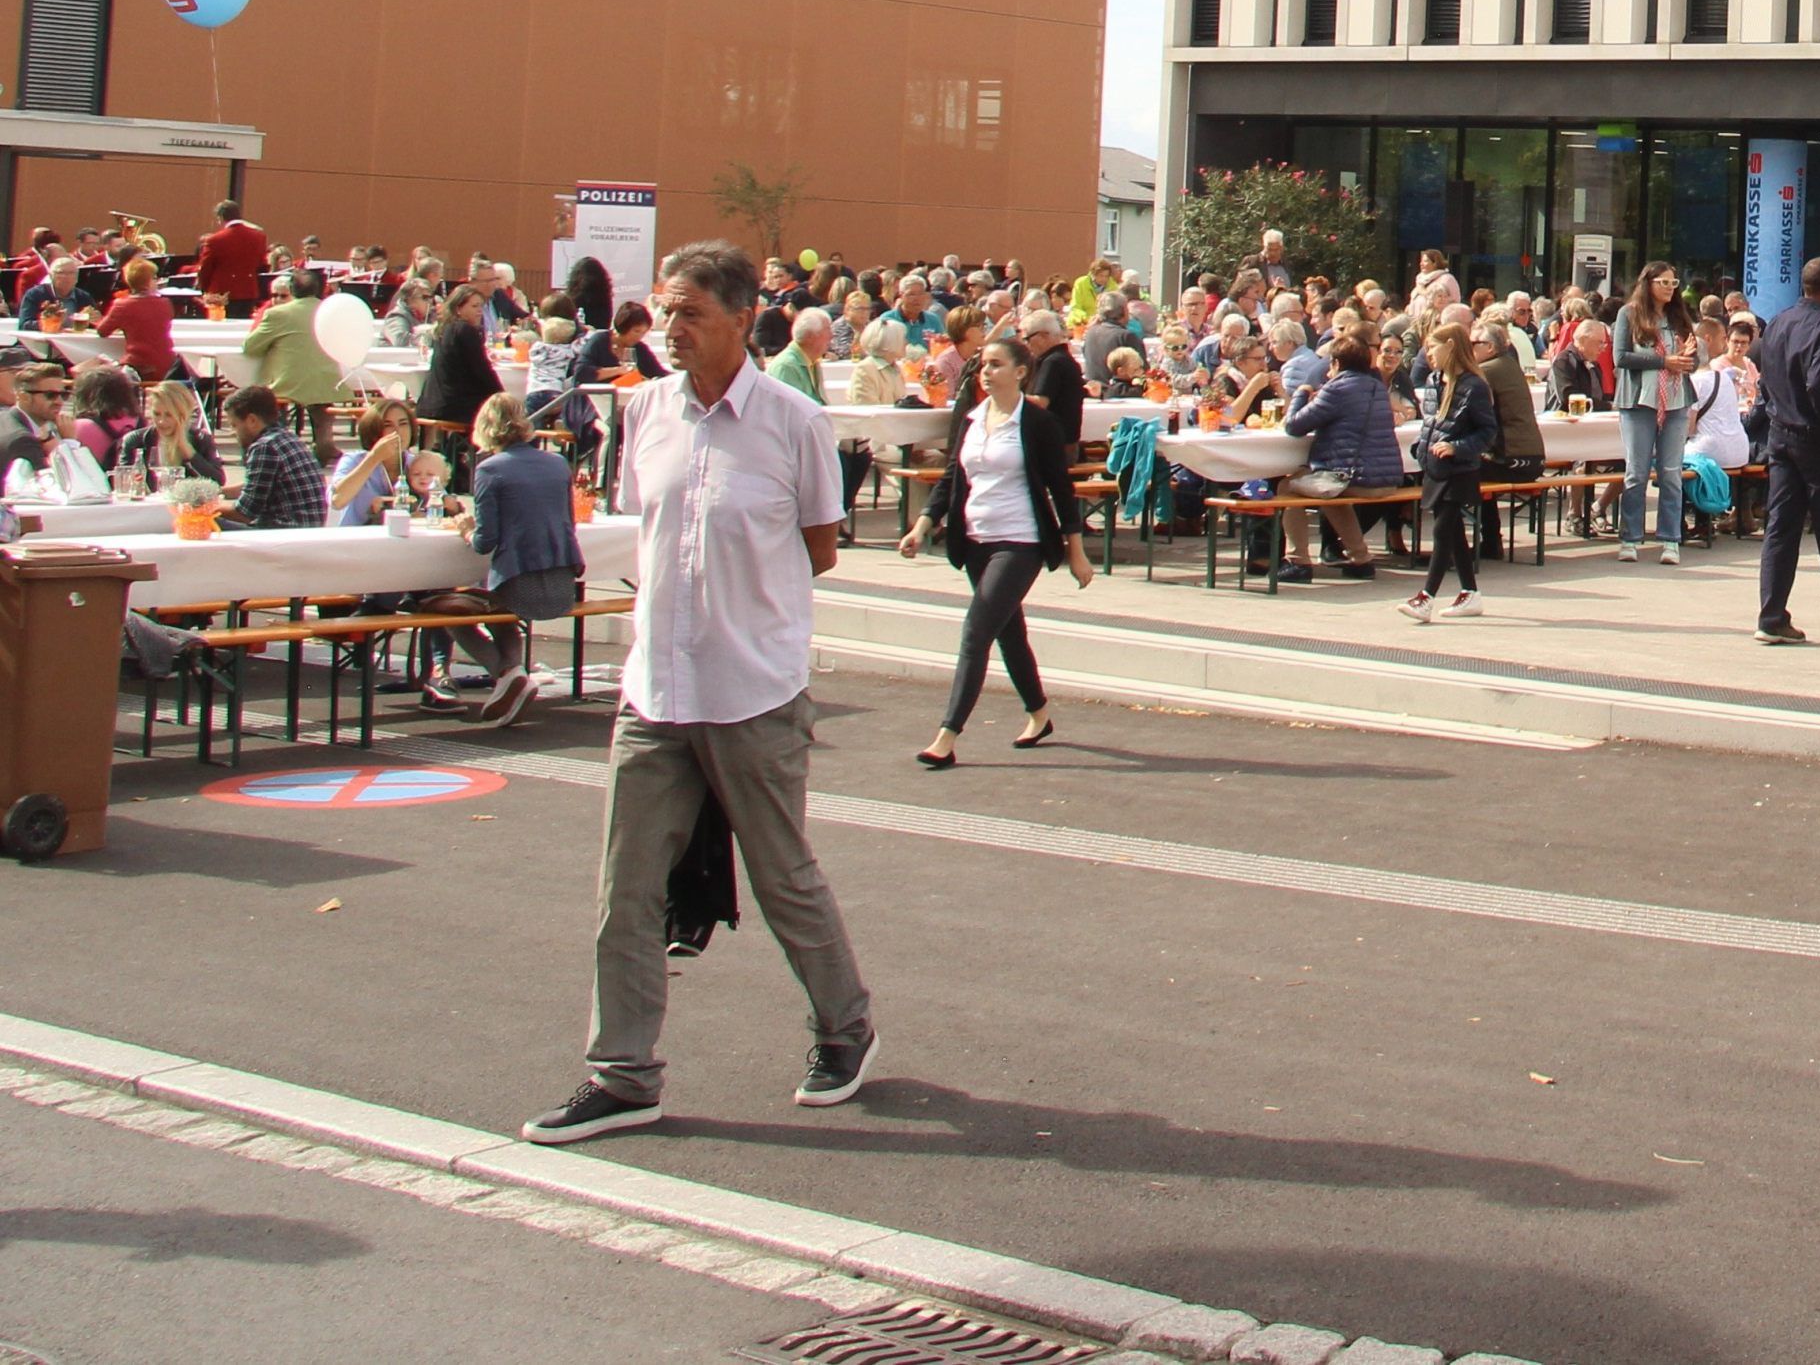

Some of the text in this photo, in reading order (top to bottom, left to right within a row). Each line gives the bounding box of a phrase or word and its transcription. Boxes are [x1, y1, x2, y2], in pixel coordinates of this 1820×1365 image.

[170, 137, 228, 148] TIEFGARAGE
[580, 190, 643, 203] POLIZEI
[1745, 177, 1761, 297] SPARKASSE
[1780, 202, 1793, 284] SPARKASSE
